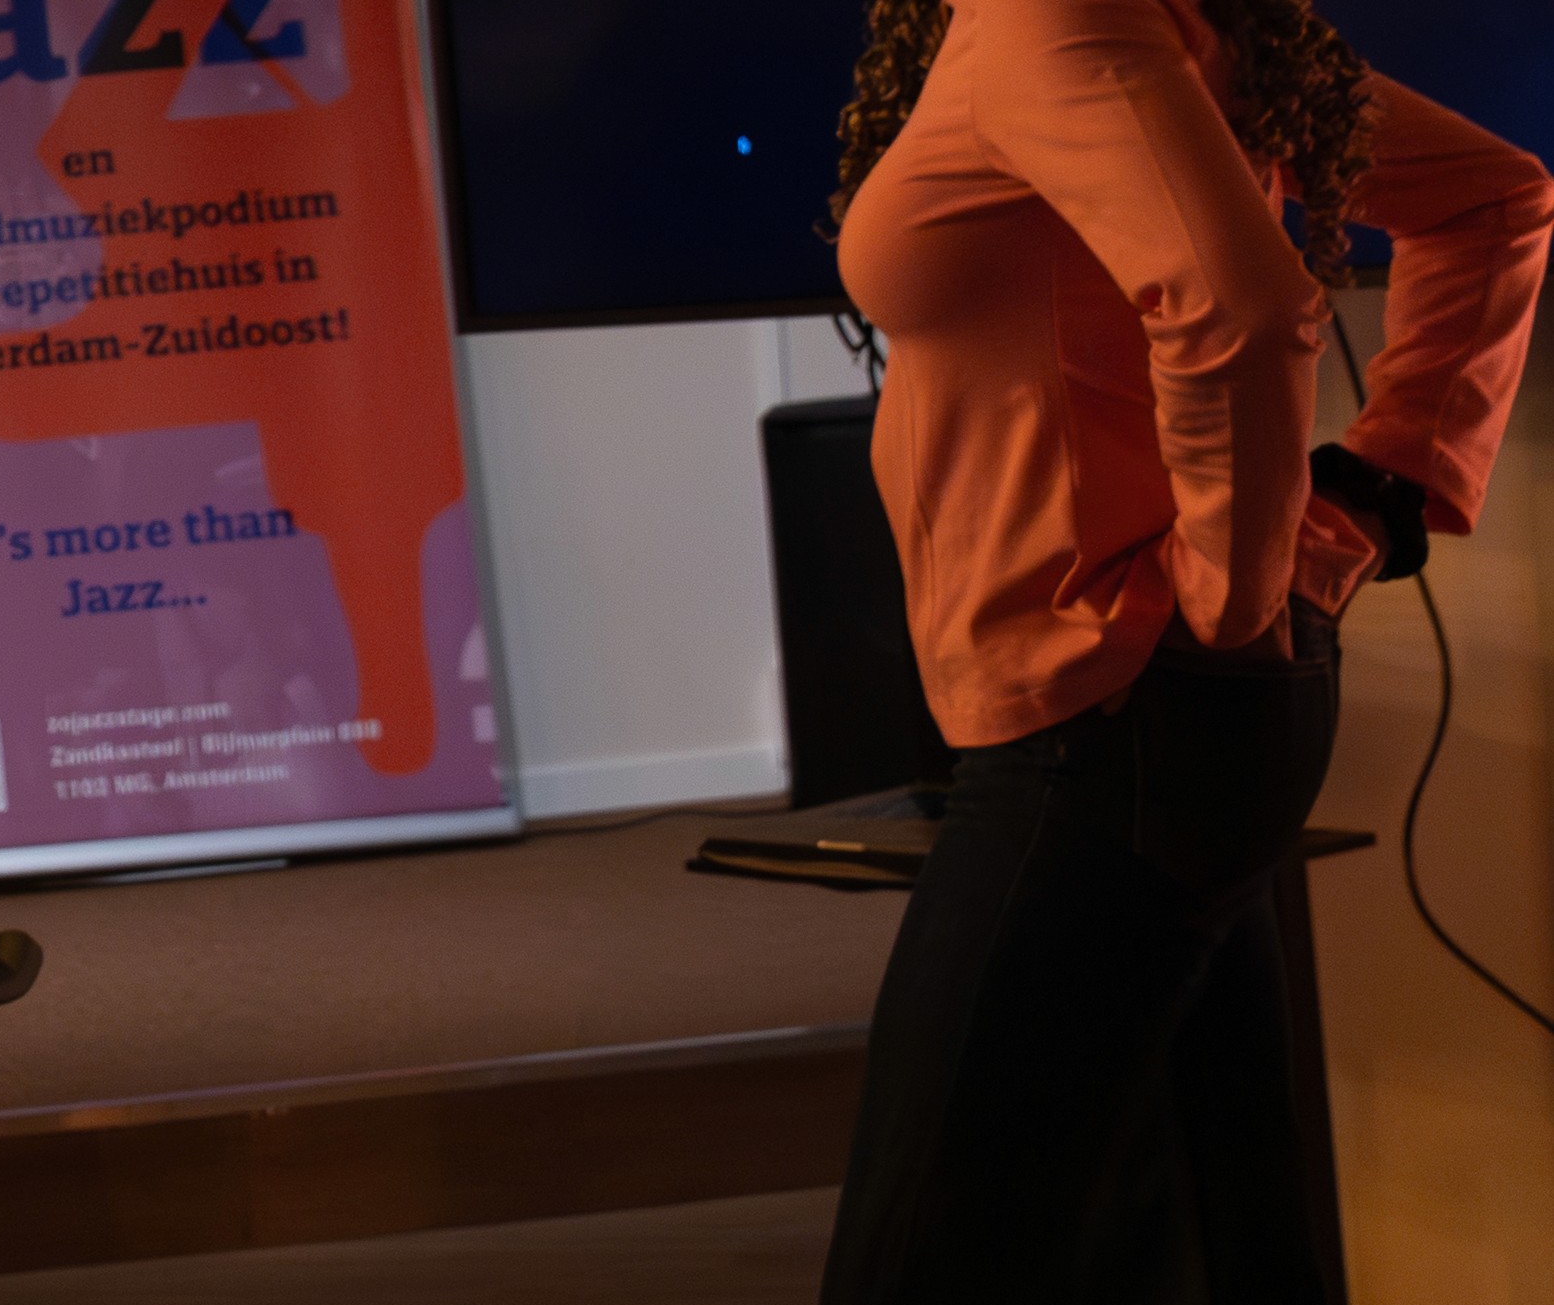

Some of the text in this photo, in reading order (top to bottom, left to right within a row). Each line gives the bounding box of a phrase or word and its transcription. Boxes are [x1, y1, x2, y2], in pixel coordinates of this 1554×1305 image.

[62, 148, 116, 178] en
[275, 249, 318, 284] in
[44, 515, 172, 557] more
[184, 504, 297, 546] than
[60, 578, 207, 617] Jazz...
